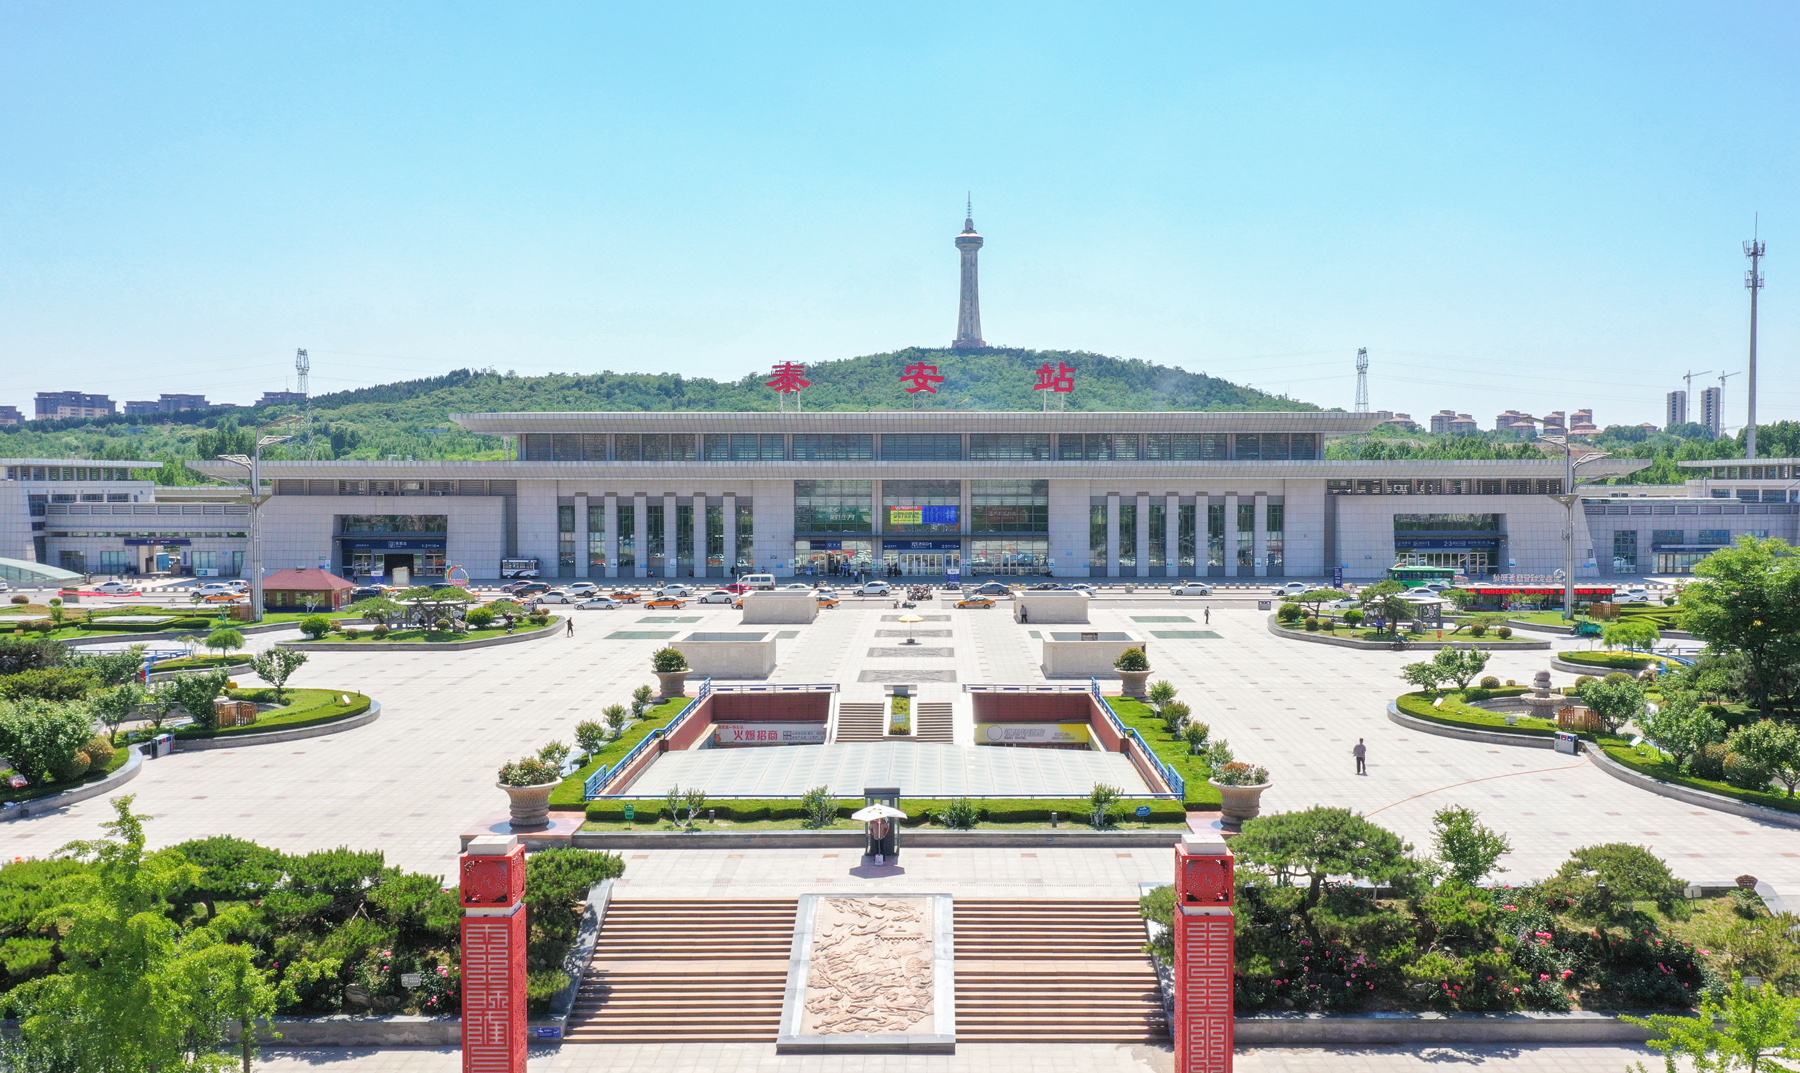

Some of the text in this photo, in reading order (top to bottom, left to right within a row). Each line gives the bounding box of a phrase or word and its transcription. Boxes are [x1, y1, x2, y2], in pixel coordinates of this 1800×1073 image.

[766, 361, 1077, 393] 泰安站
[733, 729, 779, 741] 火爆招商
